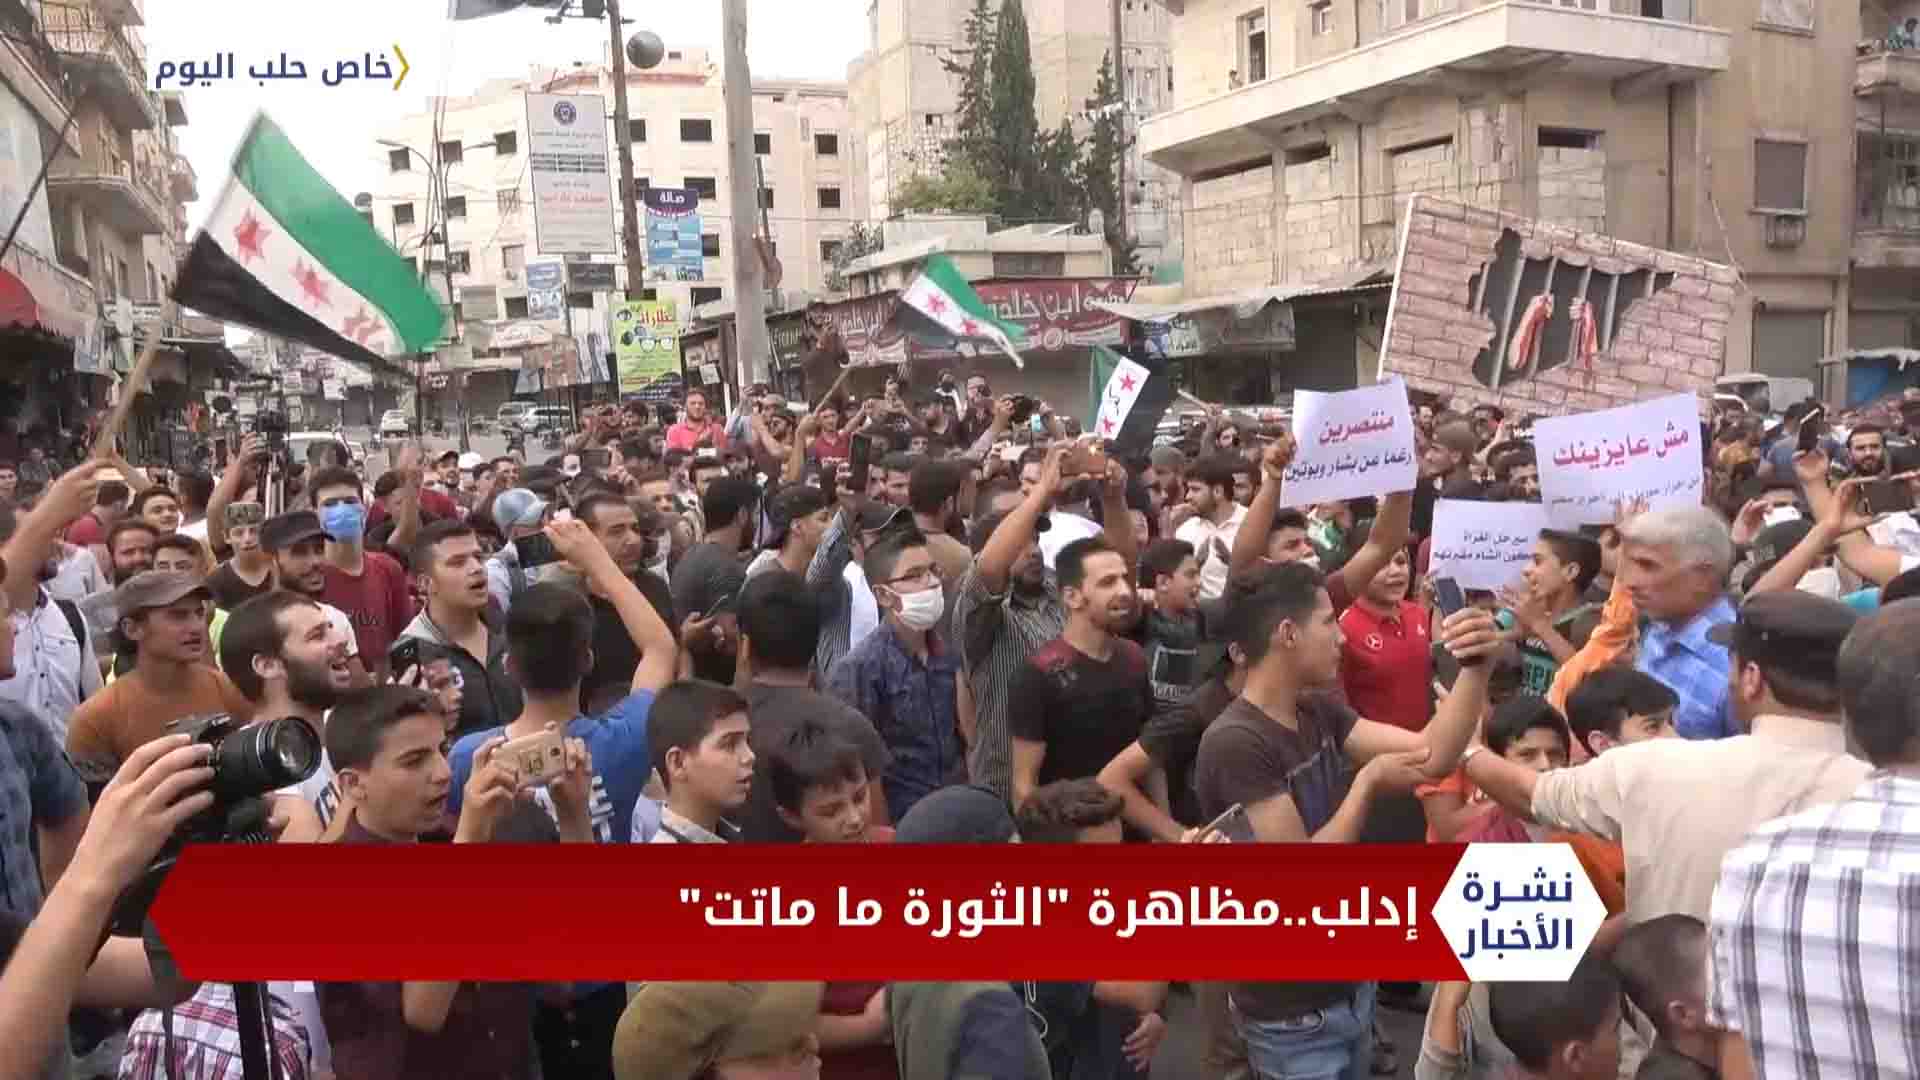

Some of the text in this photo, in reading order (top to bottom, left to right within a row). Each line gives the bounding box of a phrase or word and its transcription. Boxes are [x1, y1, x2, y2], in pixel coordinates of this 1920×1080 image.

[659, 190, 686, 204] صالة
[1318, 410, 1394, 445] منتصرين
[1552, 420, 1690, 469] مش عايزينك
[1327, 453, 1358, 476] بشار
[1359, 455, 1379, 473] عن
